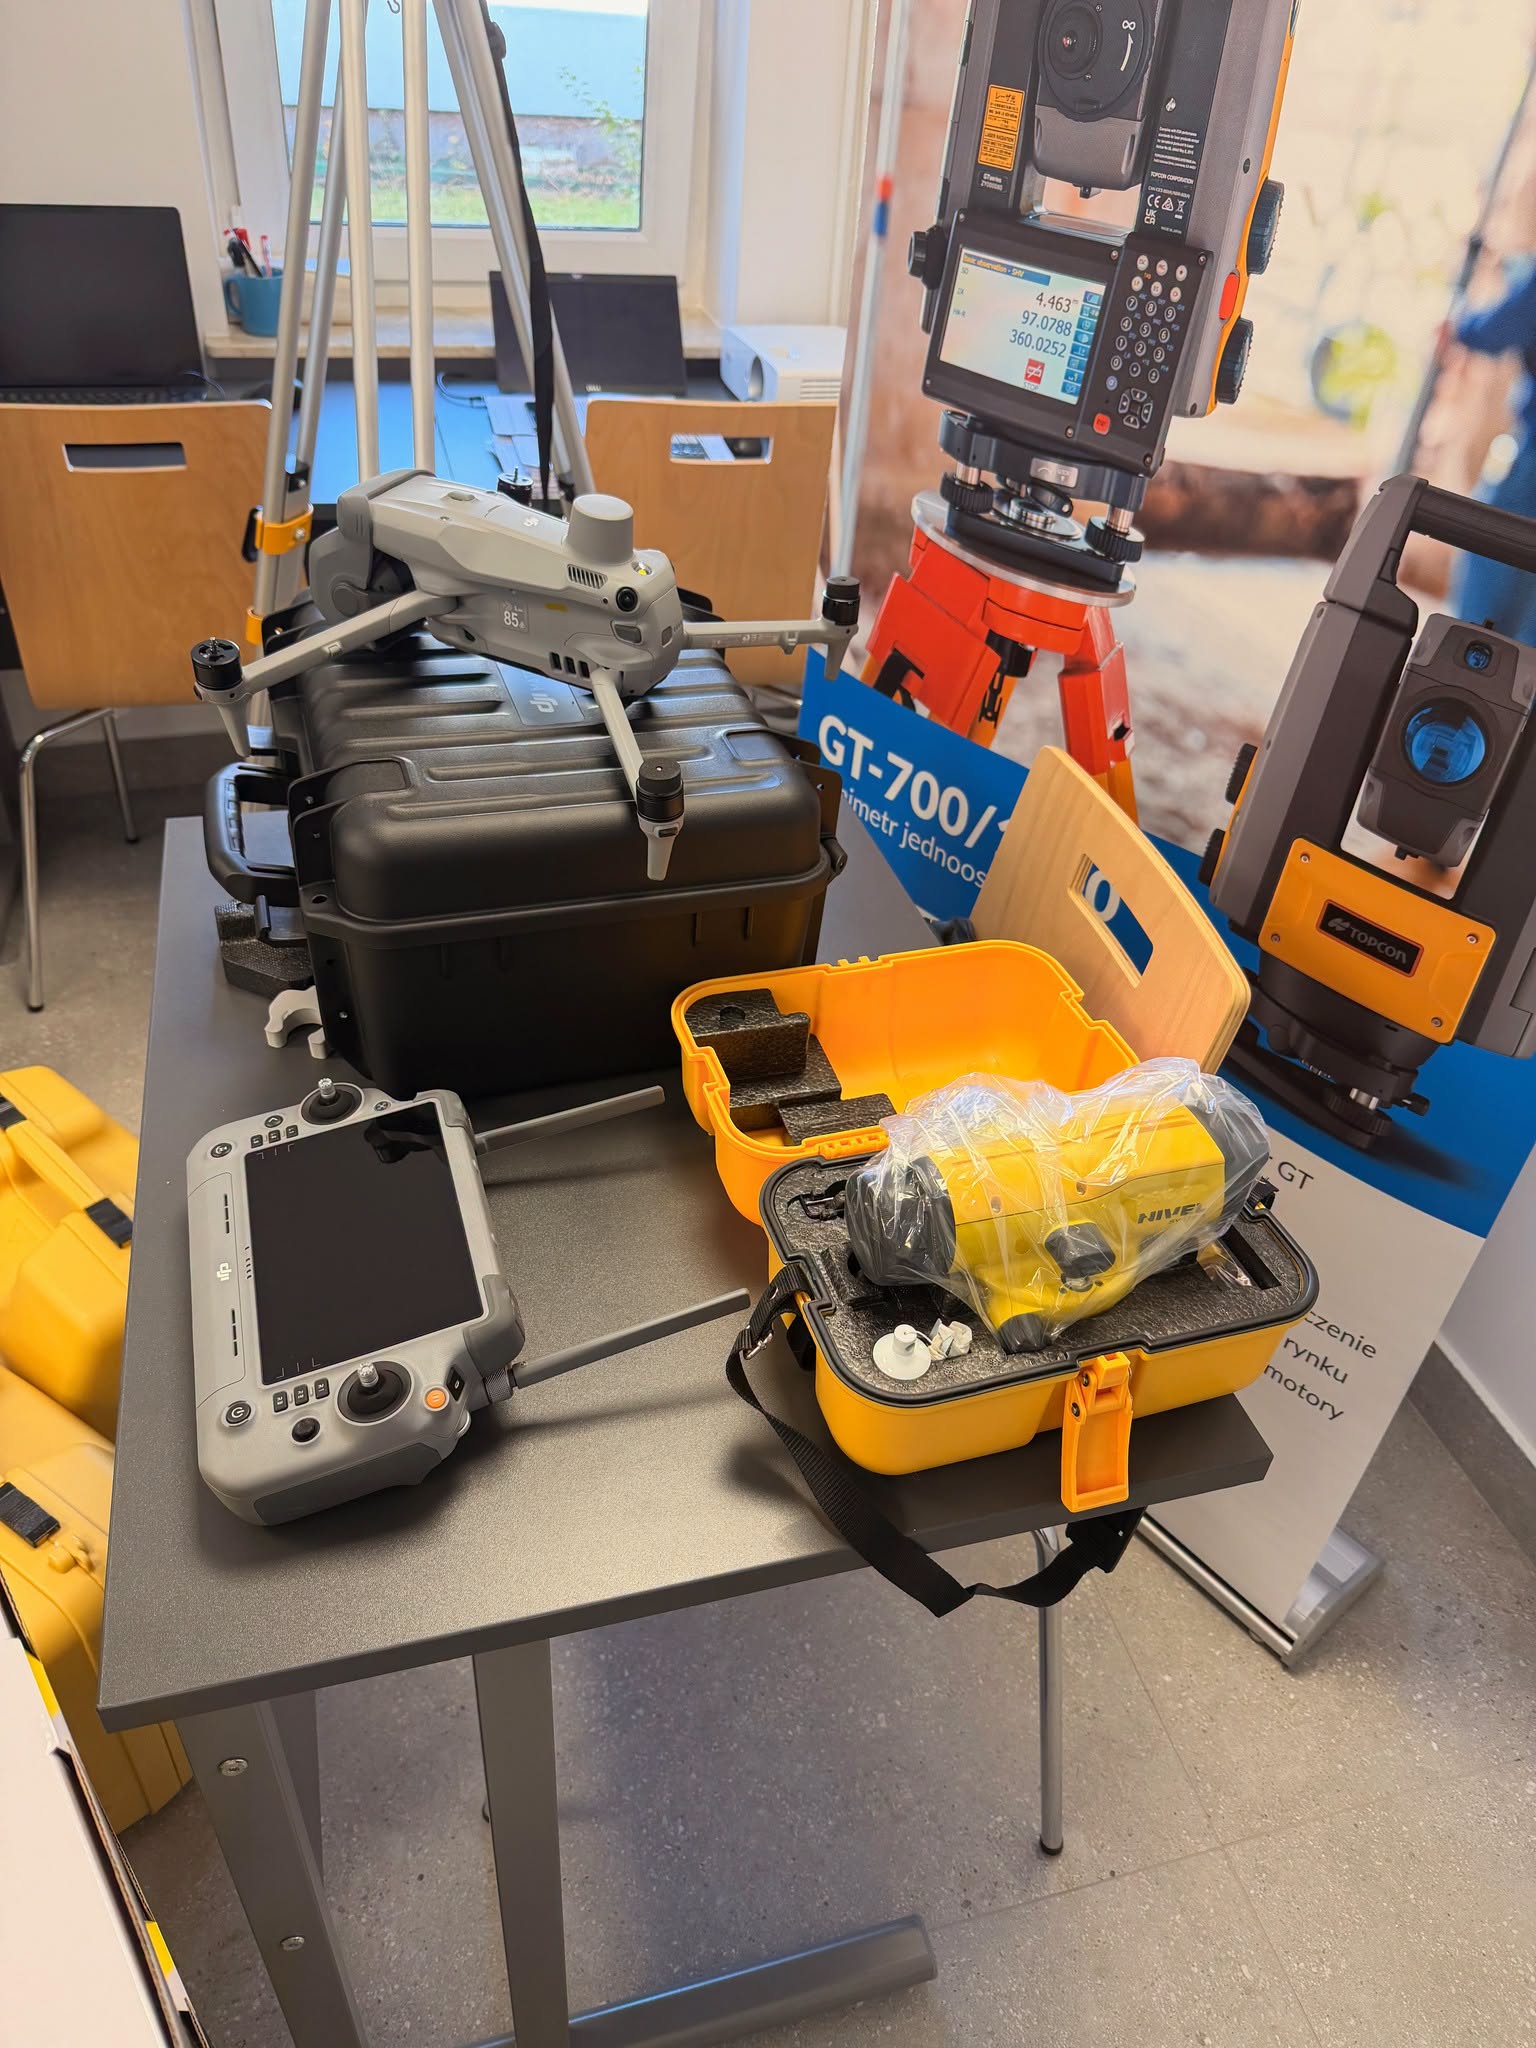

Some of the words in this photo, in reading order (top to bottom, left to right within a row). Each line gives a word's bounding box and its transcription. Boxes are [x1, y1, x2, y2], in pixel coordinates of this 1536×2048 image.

[1036, 292, 1072, 313] 4.463
[1021, 310, 1073, 337] 97.0788
[1009, 329, 1067, 358] 360.0252
[503, 610, 519, 628] 85
[818, 715, 1010, 848] GT-700/
[1350, 926, 1408, 965] TOPCON
[1278, 1161, 1314, 1190] GT
[1283, 1337, 1349, 1384] rynku
[1263, 1364, 1345, 1421] motory
